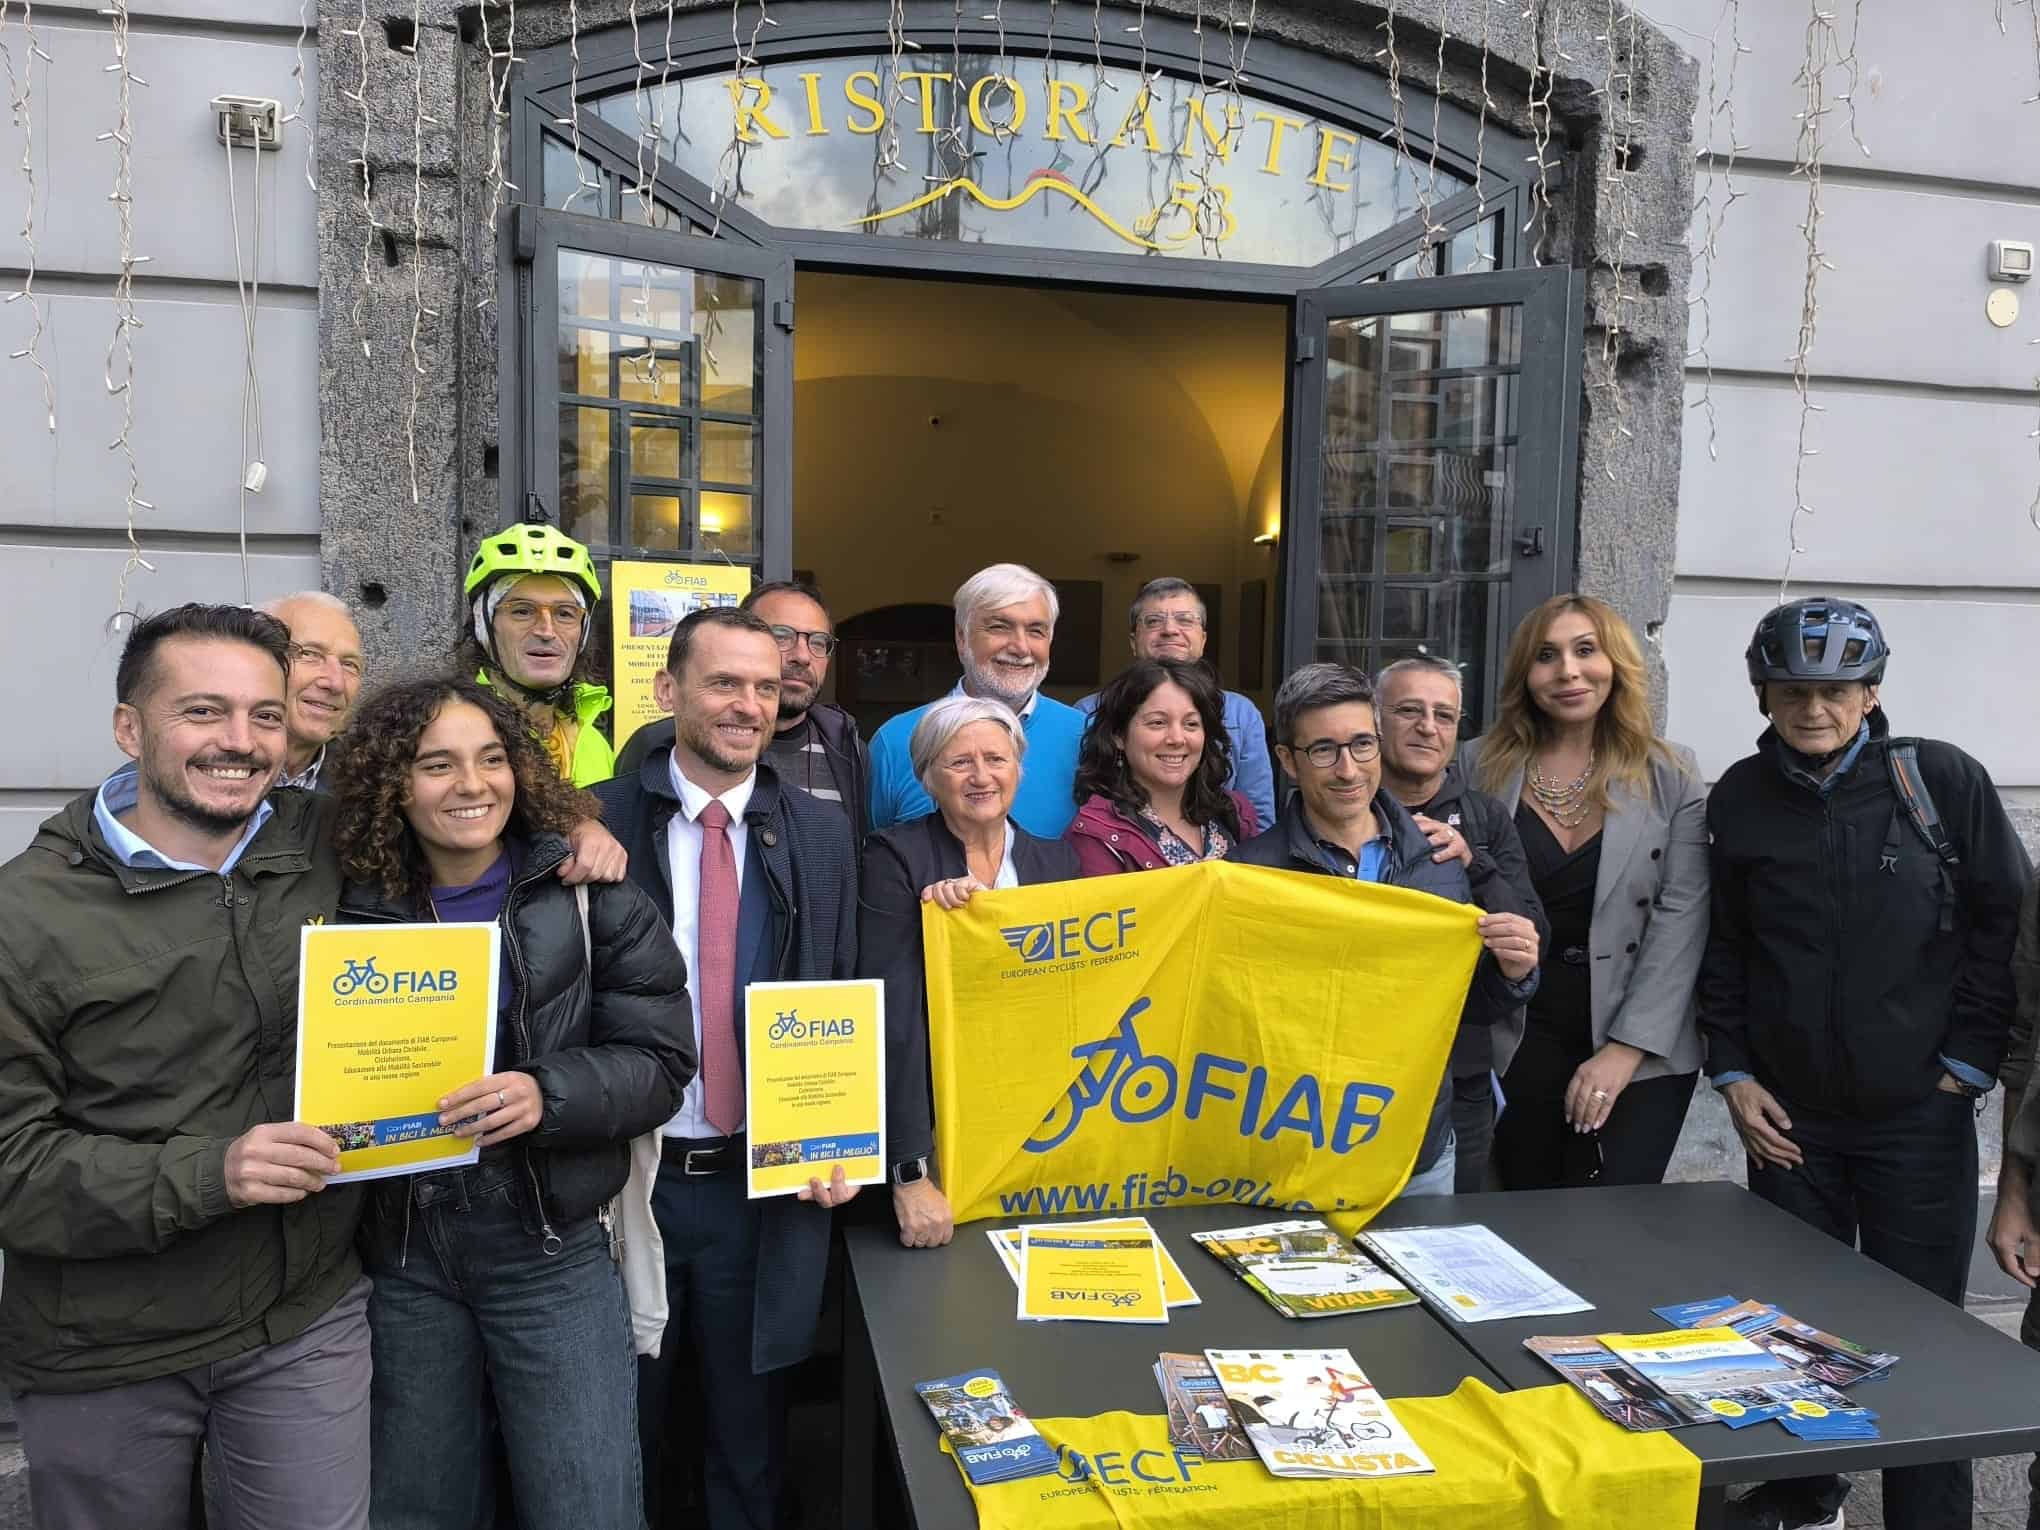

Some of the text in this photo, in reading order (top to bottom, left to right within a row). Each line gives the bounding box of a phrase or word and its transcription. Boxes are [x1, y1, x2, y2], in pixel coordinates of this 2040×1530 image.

[722, 71, 1358, 193] RISTORANTE
[1170, 182, 1238, 242] 53
[684, 576, 708, 586] FIAB
[1059, 907, 1137, 958] ECF
[1000, 967, 1046, 979] EUROPEAN
[1090, 950, 1140, 967] FEDERATION
[393, 970, 458, 994] FIAB
[334, 993, 455, 1006] Cordinamento Campania
[809, 1018, 855, 1038] FIAB
[1183, 1052, 1396, 1155] FIAB
[384, 1134, 397, 1143] IN
[399, 1130, 418, 1141] BICI
[810, 1151, 819, 1161] IN
[842, 1146, 873, 1157] MEGLIO
[1050, 1290, 1099, 1301] FIAB
[1303, 1287, 1395, 1311] VITALE
[1216, 1363, 1282, 1384] BC
[966, 1447, 1002, 1464] FIAB
[1272, 1449, 1422, 1471] CICLISTA
[1094, 1449, 1205, 1485] ECF
[1147, 1482, 1218, 1497] FEDERATION
